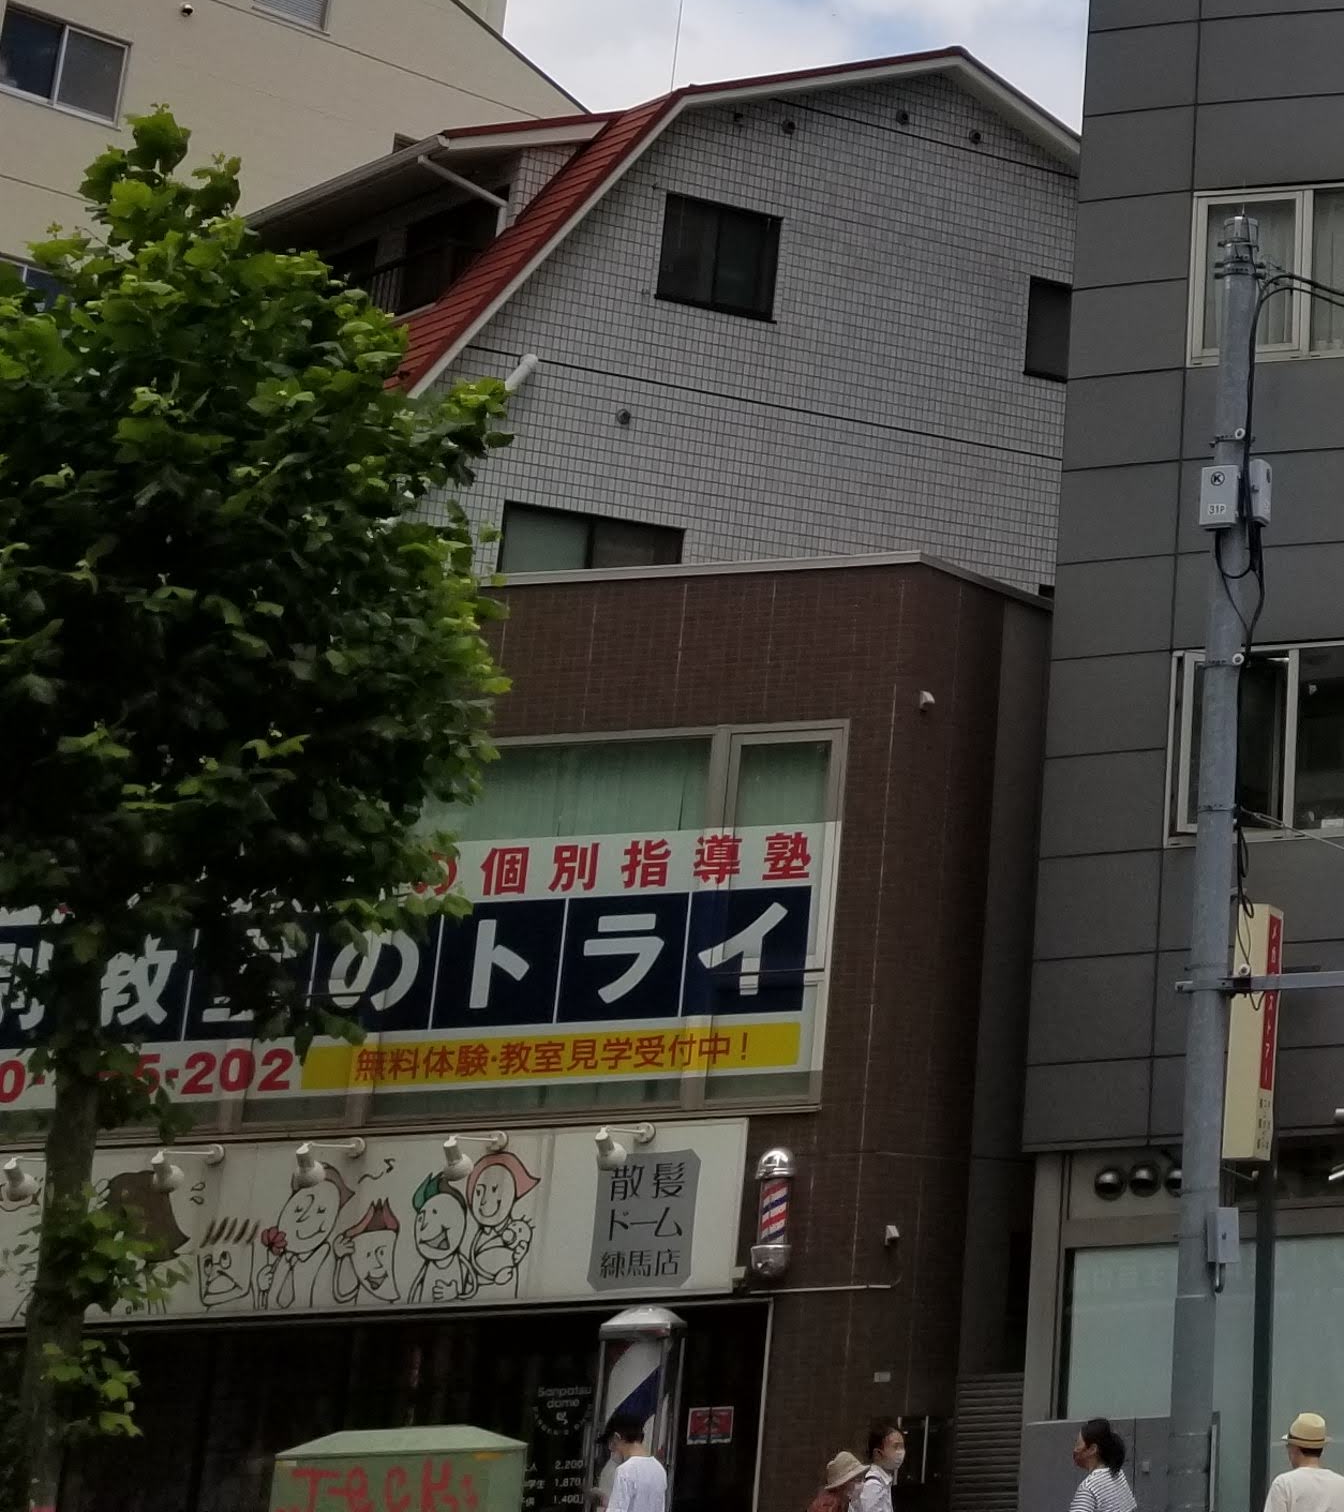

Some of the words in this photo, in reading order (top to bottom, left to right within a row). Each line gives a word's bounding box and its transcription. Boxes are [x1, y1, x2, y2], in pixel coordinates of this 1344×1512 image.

[609, 1161, 686, 1202] 散髪
[608, 1206, 683, 1241] ドーム
[600, 1248, 682, 1280] 練馬店
